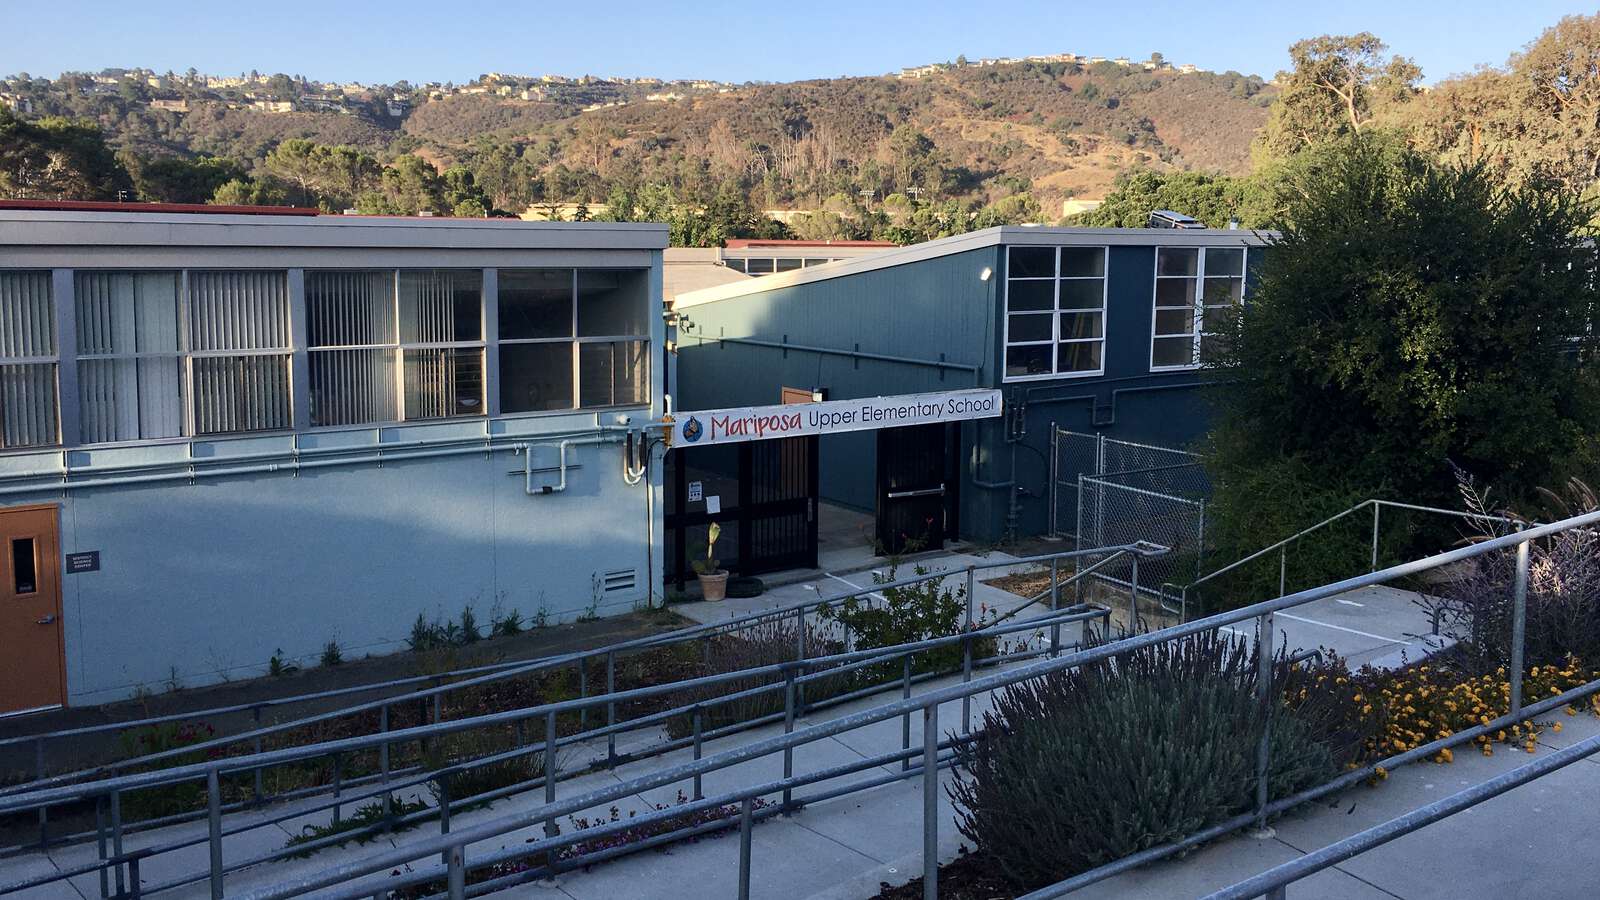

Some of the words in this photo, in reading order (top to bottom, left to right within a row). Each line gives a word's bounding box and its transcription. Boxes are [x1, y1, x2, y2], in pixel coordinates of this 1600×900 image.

[711, 412, 802, 440] Mariposa
[809, 410, 857, 429] Upper
[862, 402, 944, 422] Elementary
[948, 396, 994, 414] School
